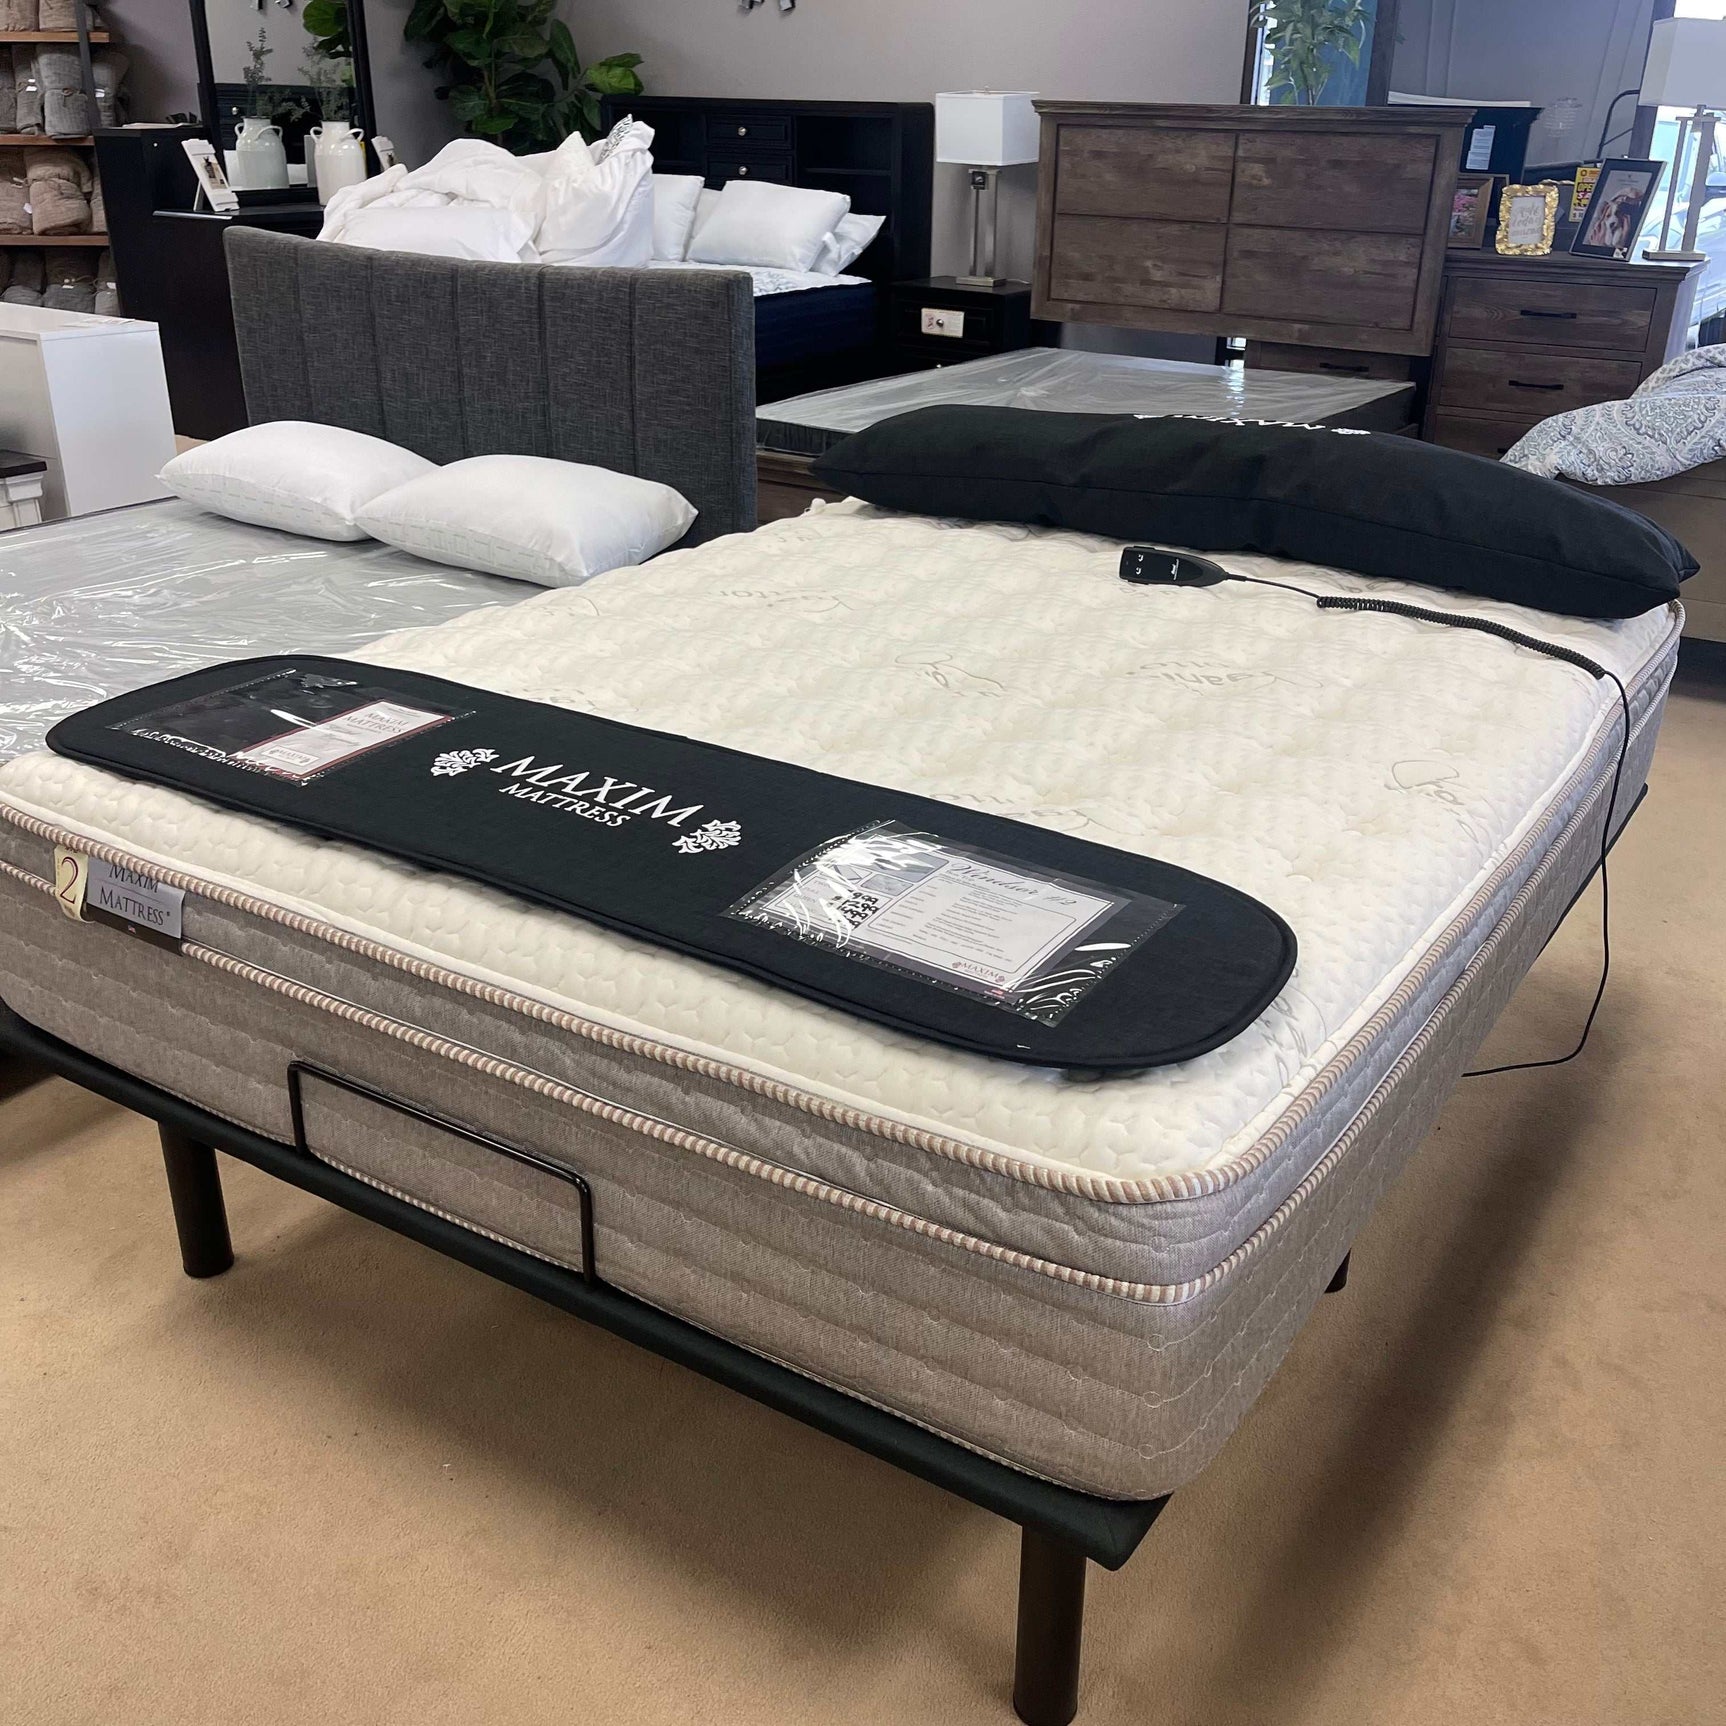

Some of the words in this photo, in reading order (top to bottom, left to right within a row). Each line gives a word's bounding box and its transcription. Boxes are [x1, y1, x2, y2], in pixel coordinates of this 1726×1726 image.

[490, 756, 704, 827] MAXIM
[498, 783, 630, 827] MATTRESS
[60, 856, 79, 905] 2
[109, 864, 159, 893] MAXIM
